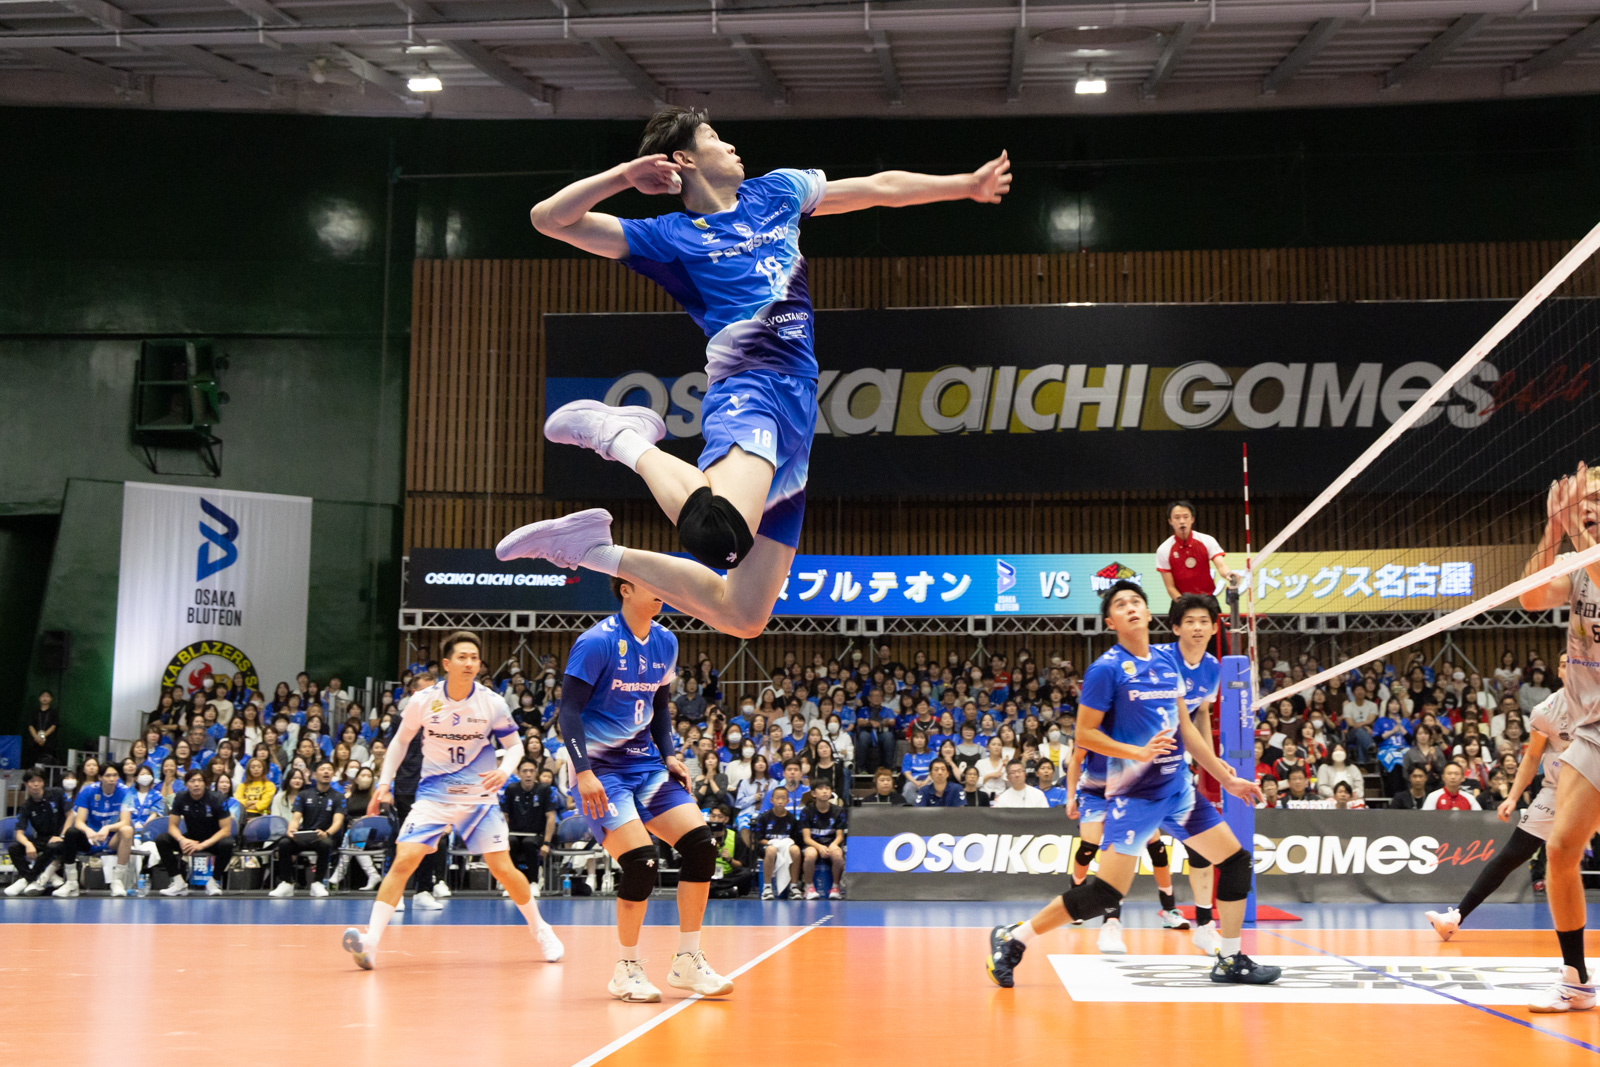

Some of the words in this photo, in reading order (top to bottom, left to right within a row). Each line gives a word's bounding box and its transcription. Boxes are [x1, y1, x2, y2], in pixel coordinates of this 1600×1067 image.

[752, 427, 772, 447] 18
[777, 569, 972, 603] ブルテオン
[1040, 571, 1071, 599] VS
[195, 589, 236, 607] OSAKA
[187, 607, 242, 627] BLUTEON
[177, 642, 251, 672] BLAZERS
[611, 678, 662, 692] Panasoni
[634, 699, 645, 725] 8
[1156, 706, 1170, 731] 3
[448, 746, 465, 764] 16
[608, 803, 619, 817] 8
[1124, 830, 1136, 845] 3
